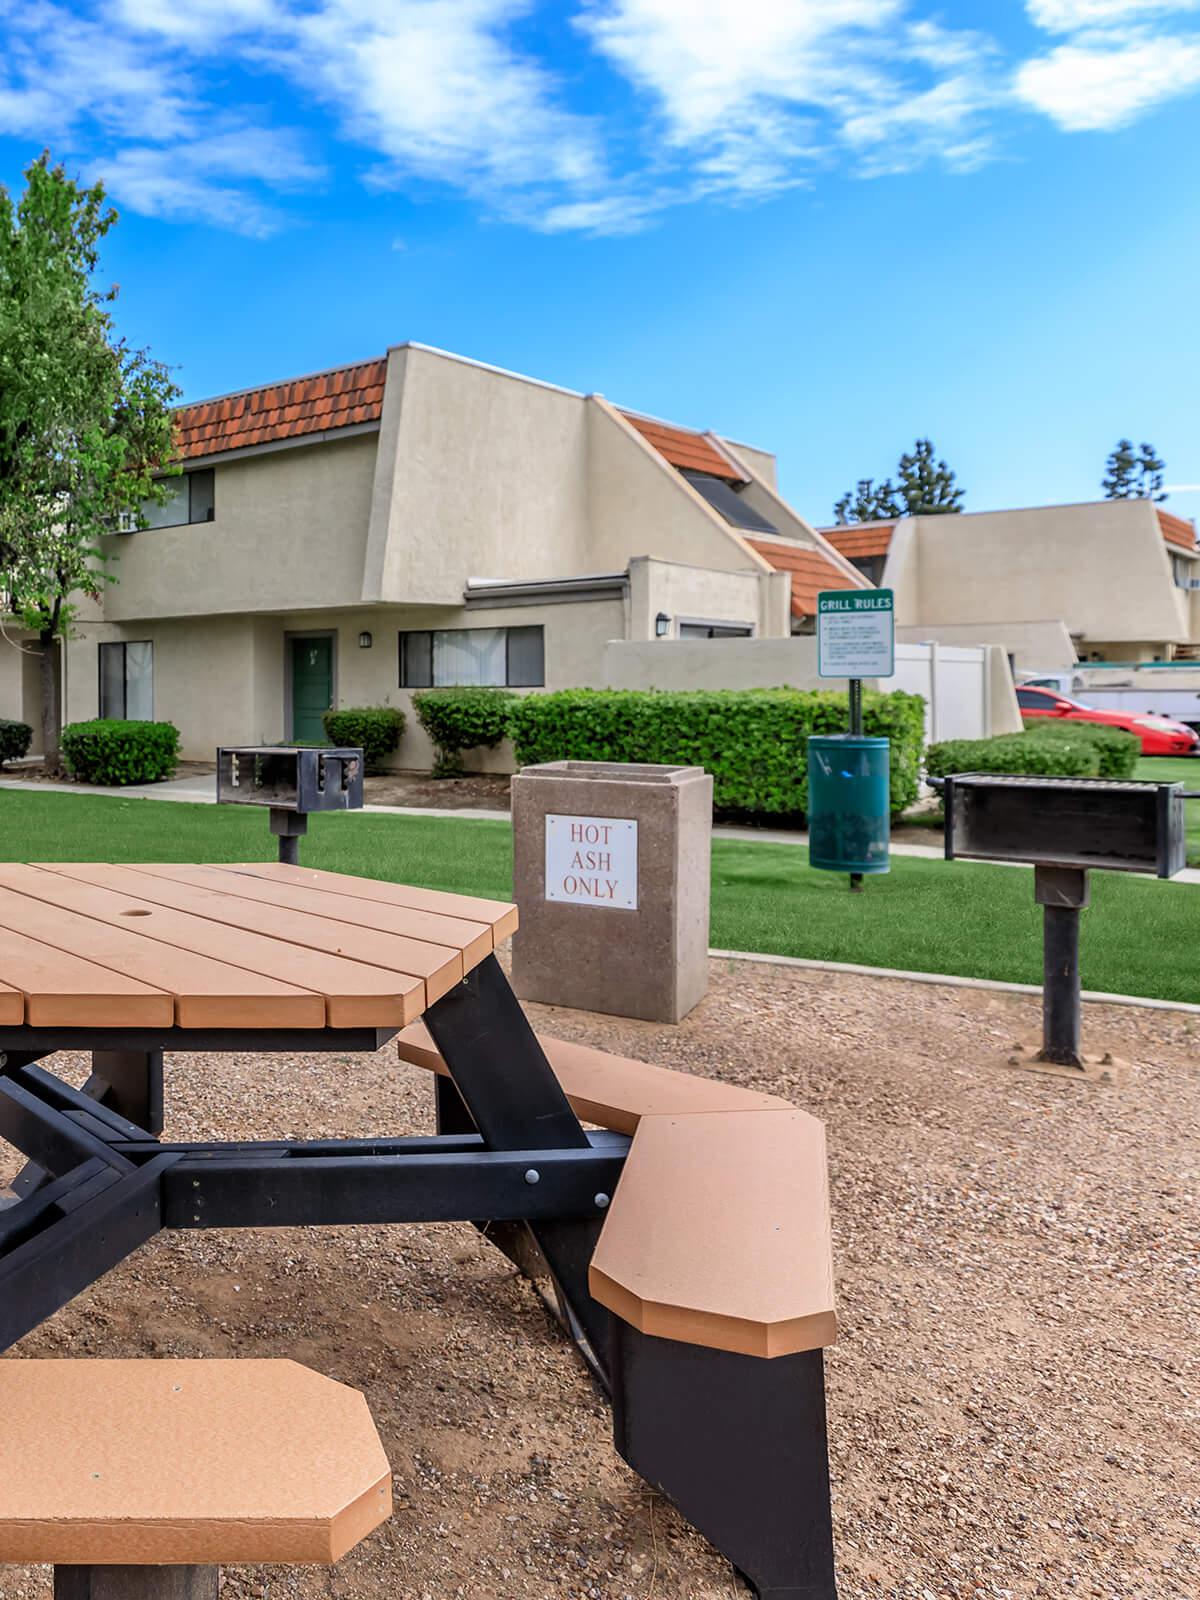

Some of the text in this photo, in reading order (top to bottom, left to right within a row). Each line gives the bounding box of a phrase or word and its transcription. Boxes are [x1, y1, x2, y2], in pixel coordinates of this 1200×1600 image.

[820, 598, 891, 611] GRILL RULES
[571, 823, 612, 844] HOT
[571, 851, 611, 872] ASH
[563, 875, 619, 899] ONLY
